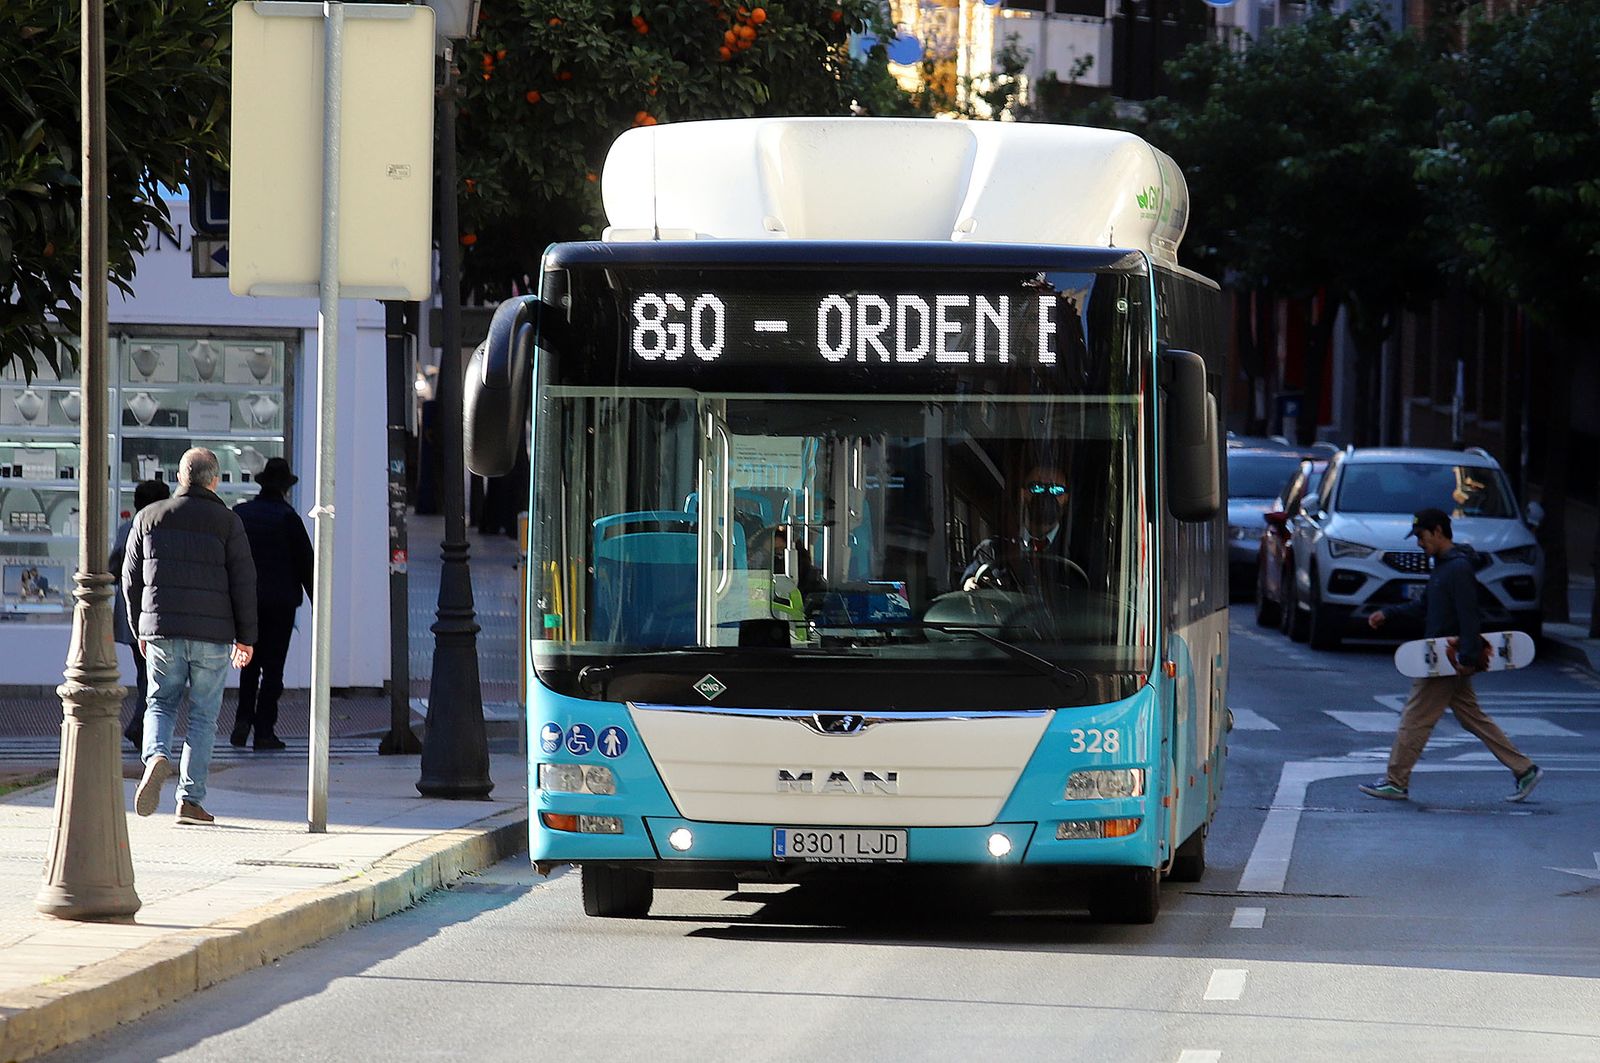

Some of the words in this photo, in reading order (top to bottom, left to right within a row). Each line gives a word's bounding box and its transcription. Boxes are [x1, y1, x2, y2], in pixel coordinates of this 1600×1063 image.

[754, 320, 788, 332] -
[817, 294, 1009, 363] ORDEN
[701, 683, 719, 691] CNG
[1070, 729, 1120, 753] 328
[778, 769, 900, 794] MAN
[793, 833, 845, 854] 8301
[857, 834, 897, 854] LJD
